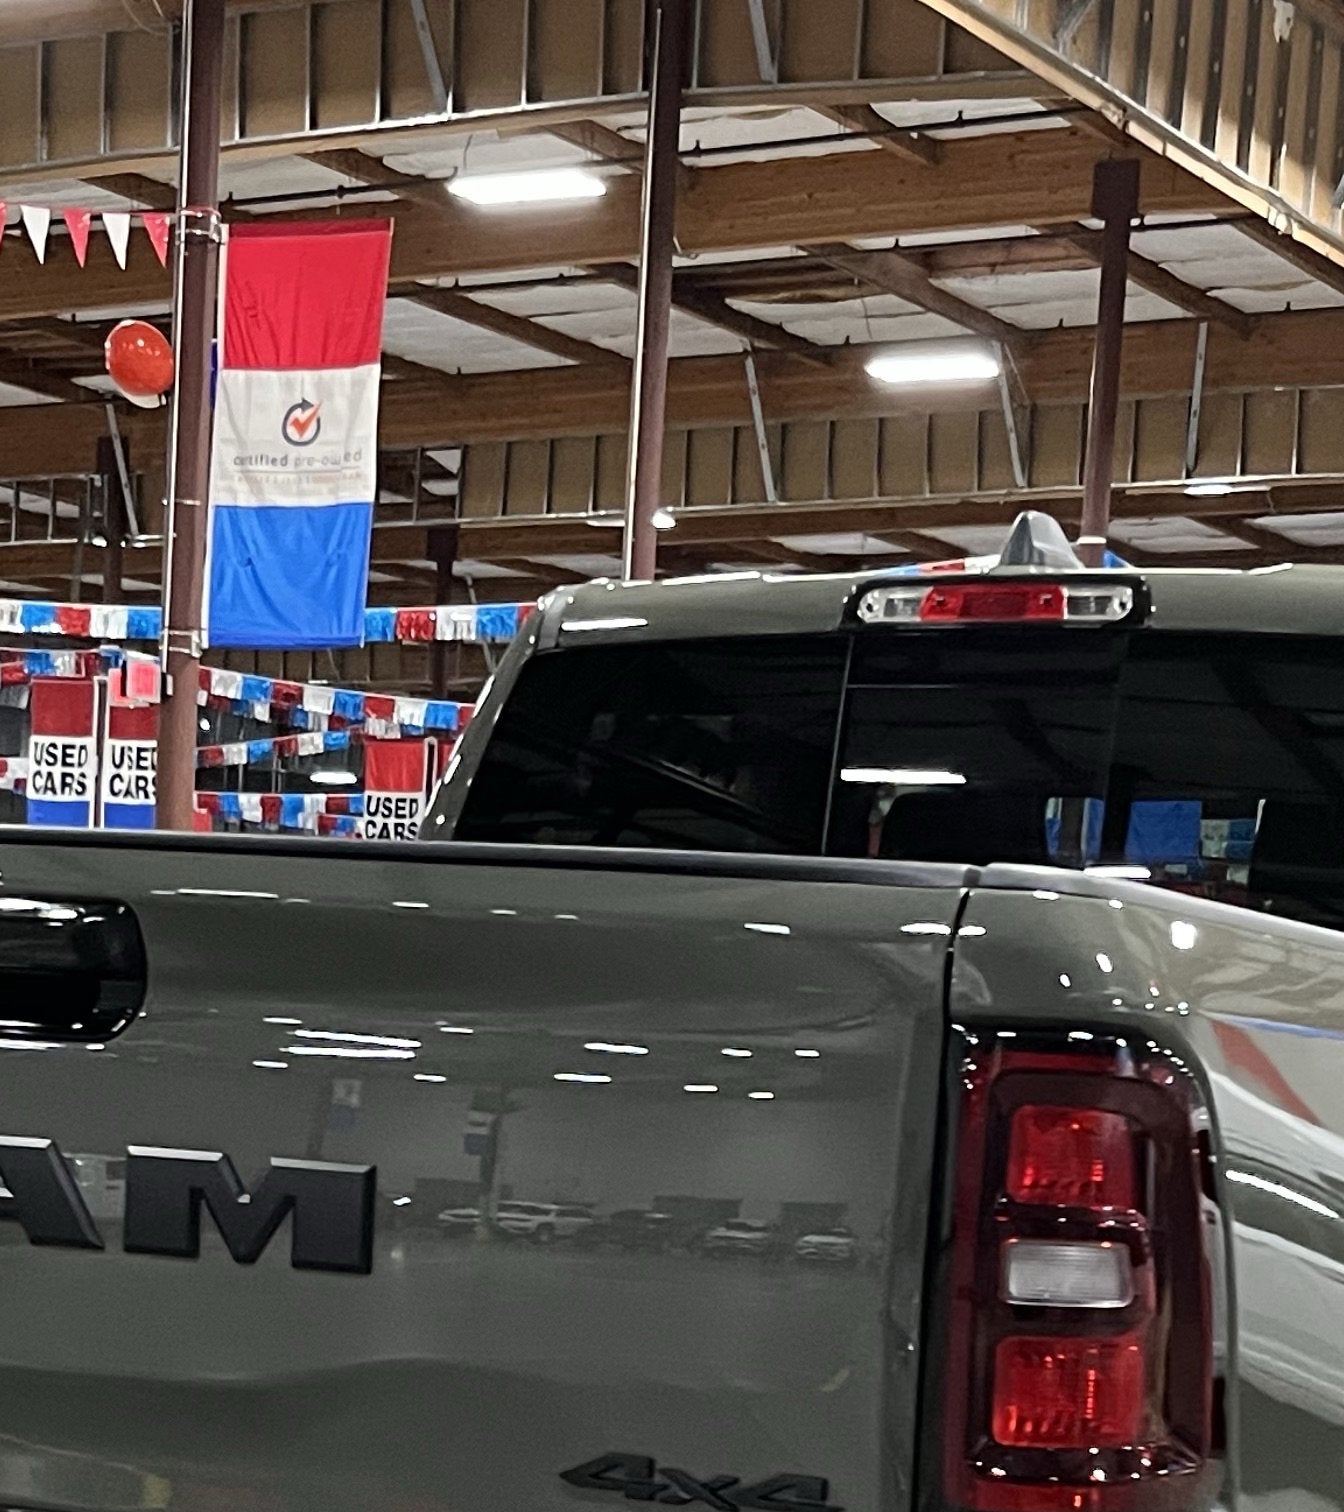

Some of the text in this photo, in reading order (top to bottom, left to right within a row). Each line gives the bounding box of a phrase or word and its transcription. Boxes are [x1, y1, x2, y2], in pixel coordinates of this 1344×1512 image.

[34, 741, 88, 768] USED
[32, 770, 88, 797] CARS
[366, 795, 419, 819] USED
